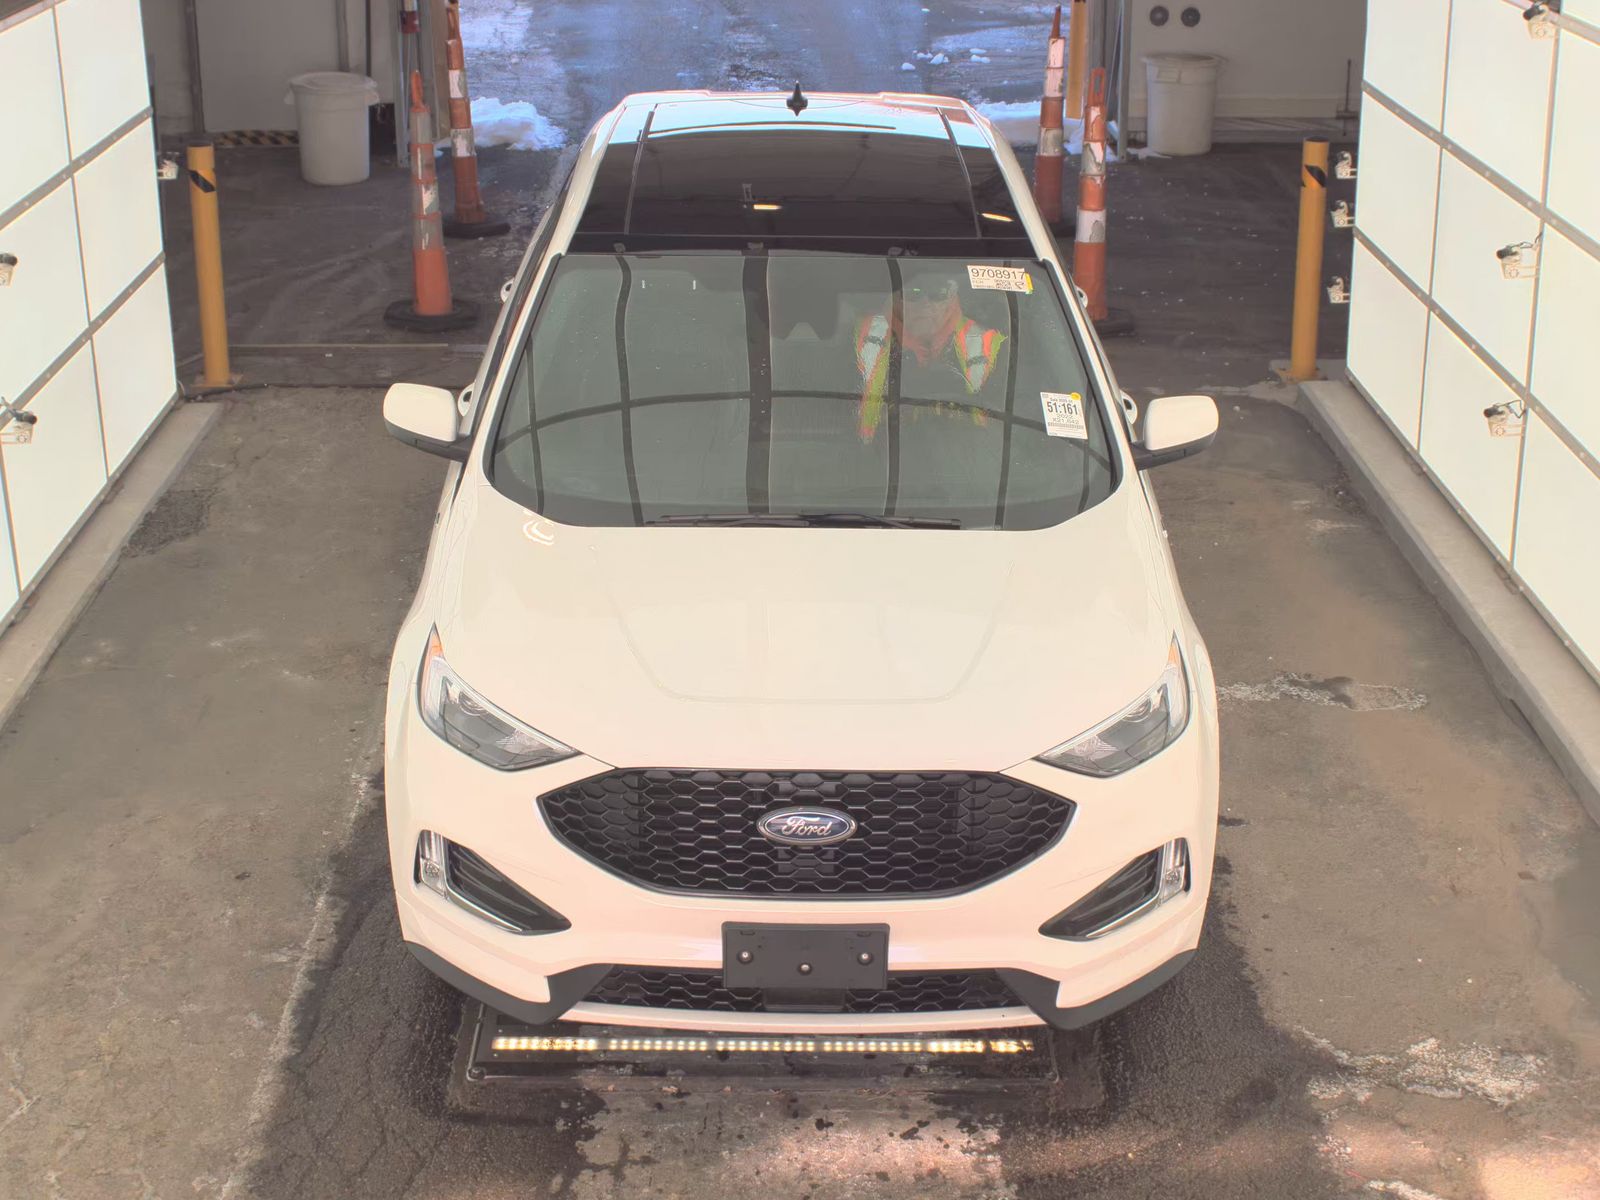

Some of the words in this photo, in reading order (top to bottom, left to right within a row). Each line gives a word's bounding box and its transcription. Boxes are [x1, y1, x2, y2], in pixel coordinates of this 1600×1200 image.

[971, 268, 1025, 280] 9708917
[1047, 401, 1078, 415] 51:161
[781, 816, 833, 836] Ford
